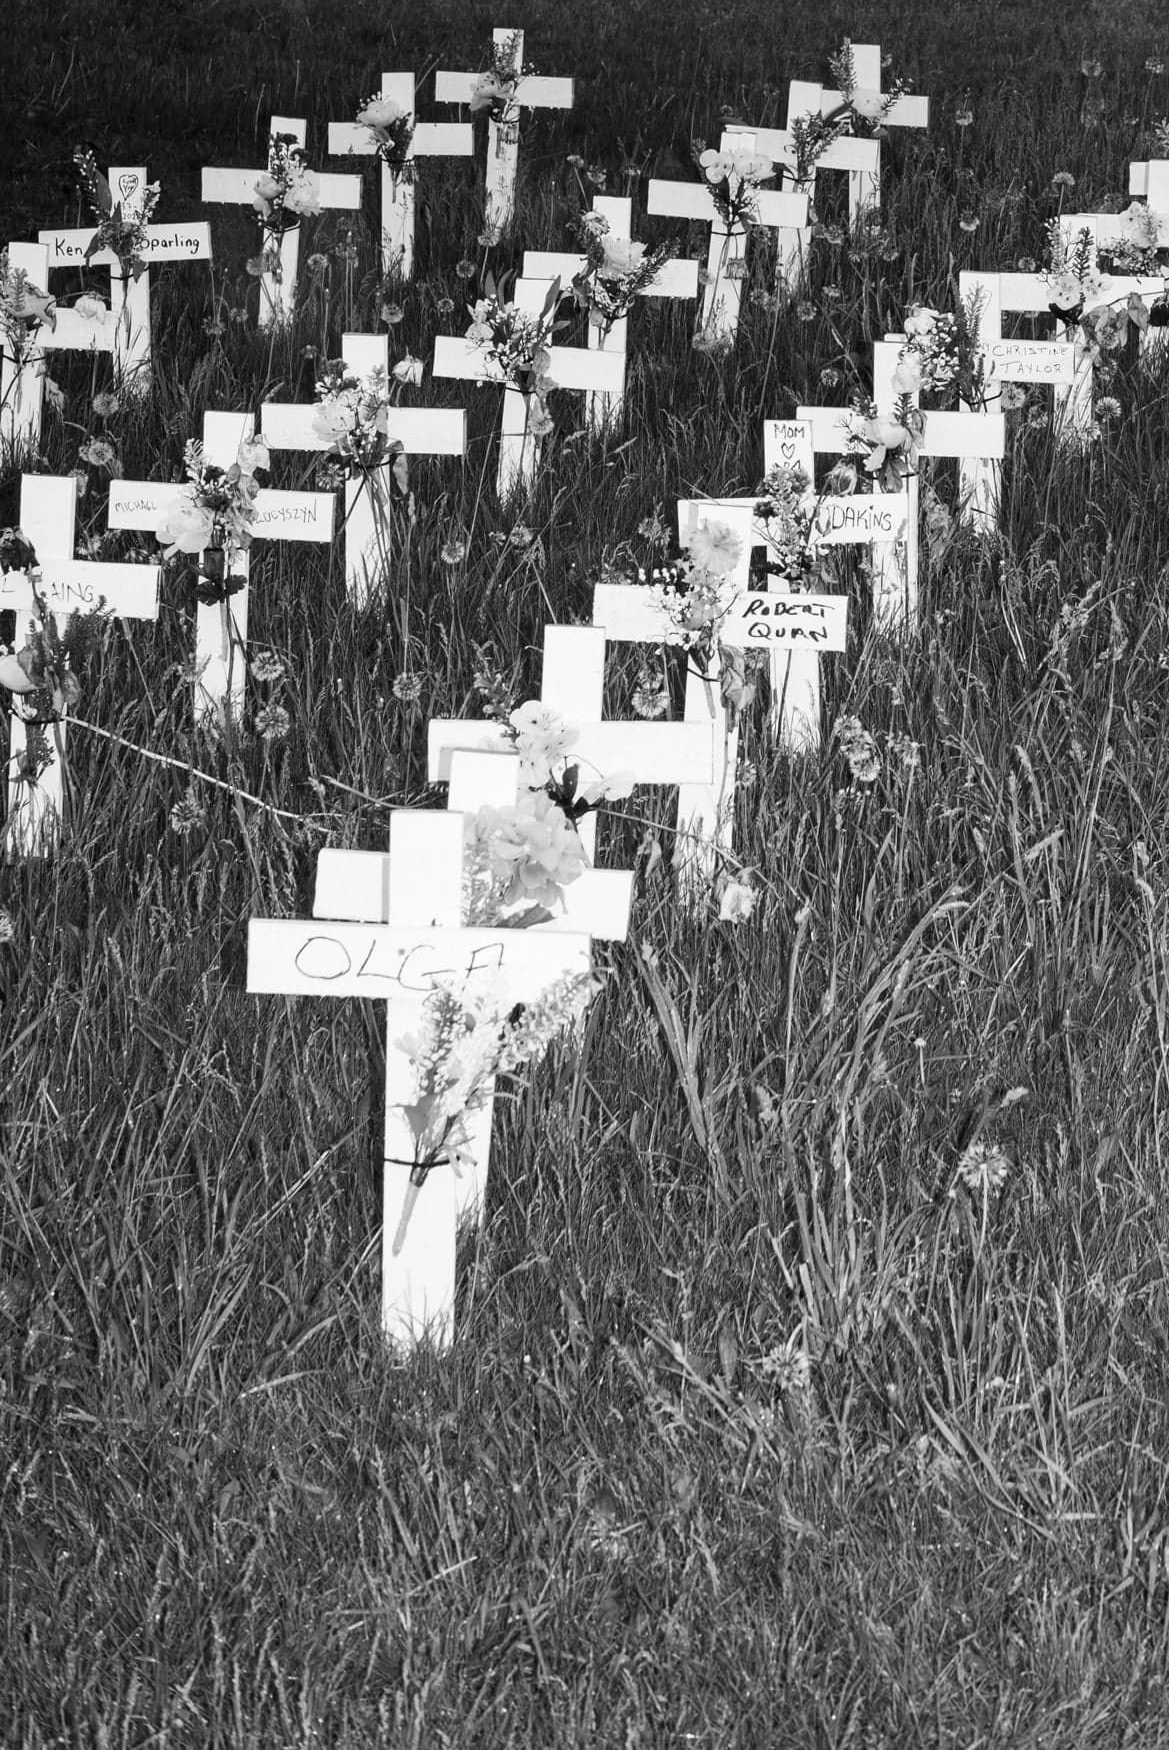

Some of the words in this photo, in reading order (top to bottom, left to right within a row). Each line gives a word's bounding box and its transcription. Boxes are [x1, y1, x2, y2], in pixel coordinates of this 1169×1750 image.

[55, 237, 84, 257] Ken
[992, 345, 1069, 357] CHRISTINE
[1000, 360, 1062, 375] TAYLOR
[774, 423, 805, 439] MOM
[742, 599, 836, 618] ROBERT
